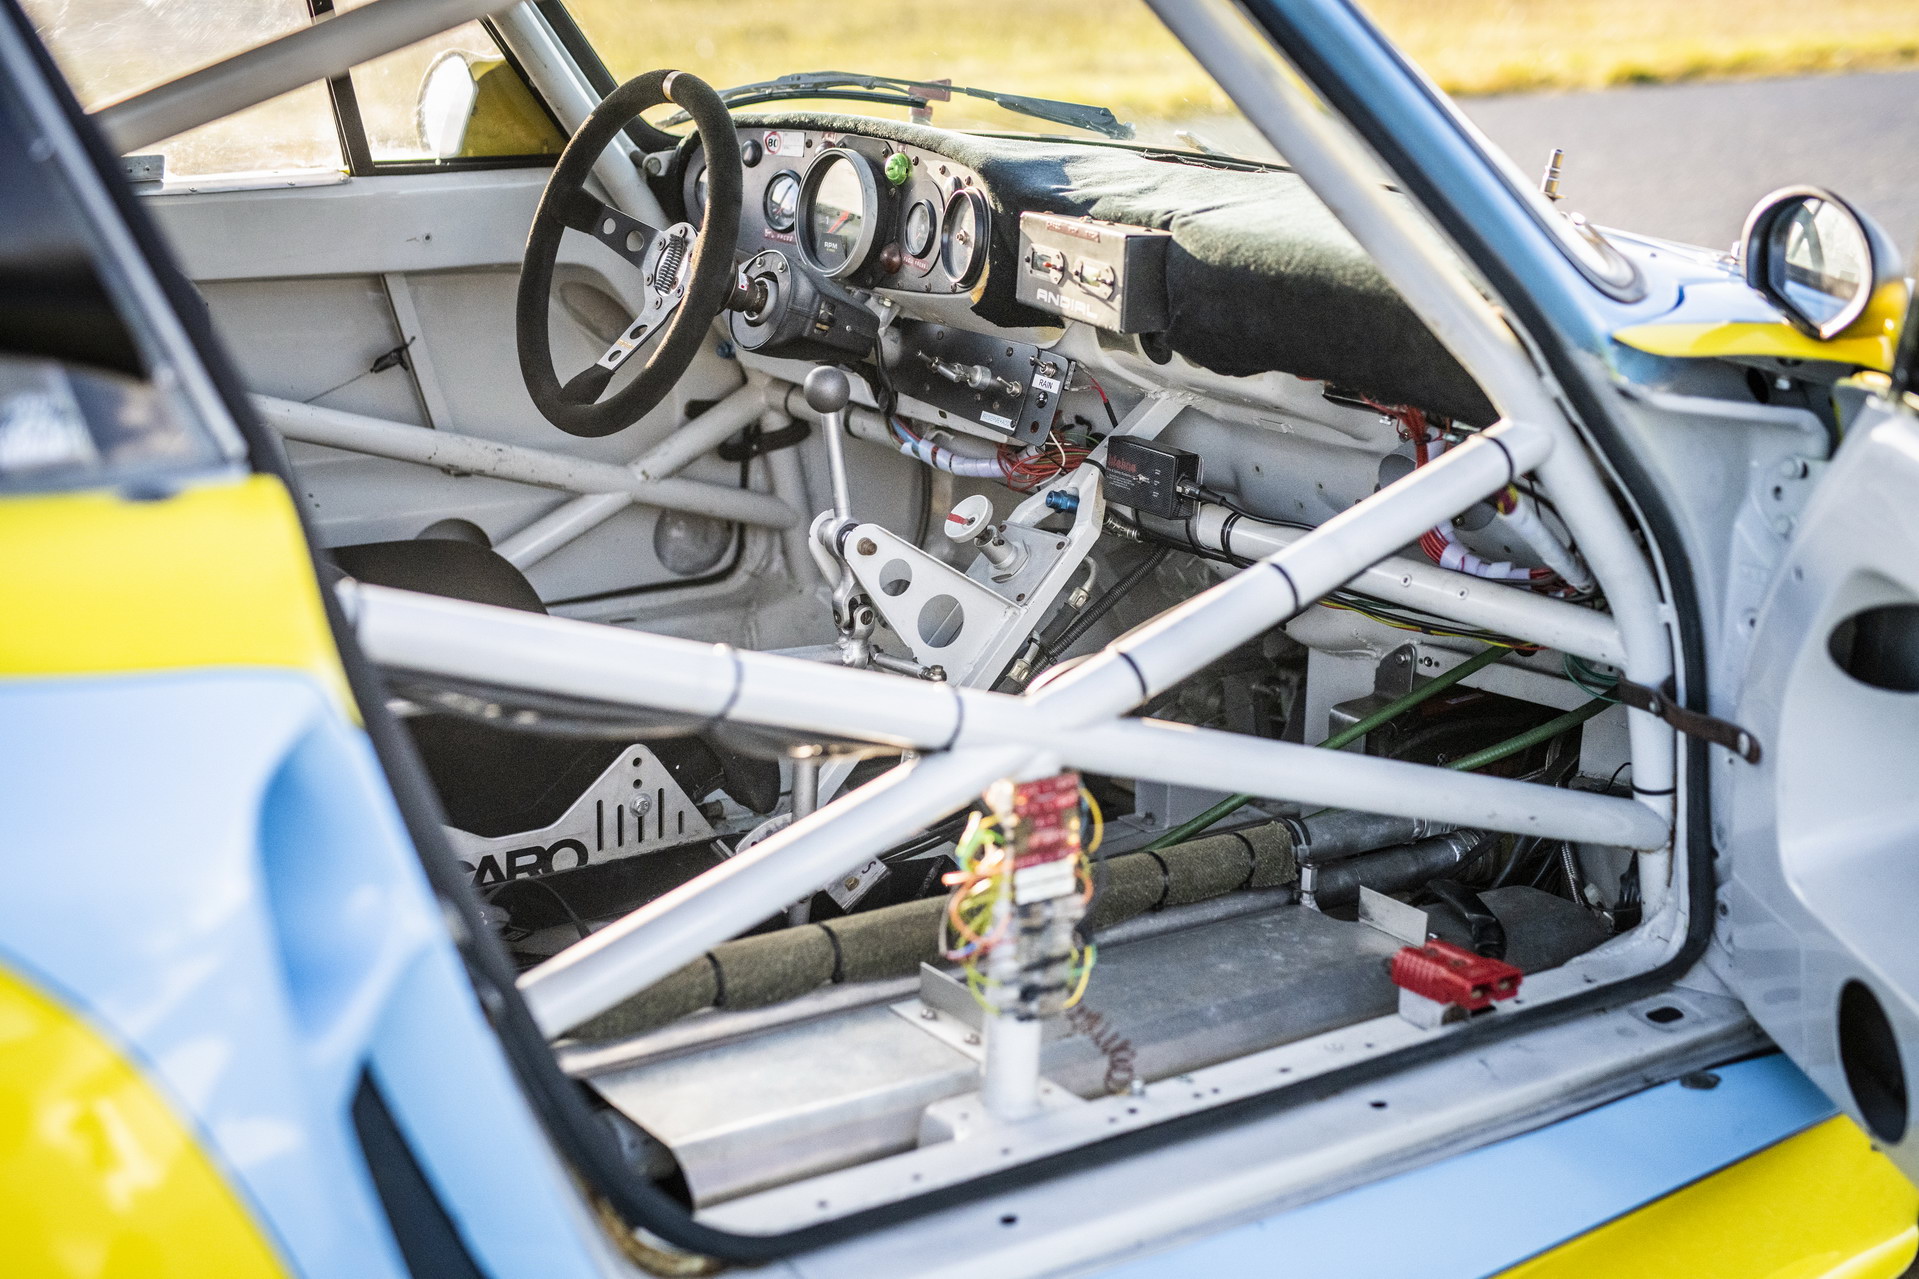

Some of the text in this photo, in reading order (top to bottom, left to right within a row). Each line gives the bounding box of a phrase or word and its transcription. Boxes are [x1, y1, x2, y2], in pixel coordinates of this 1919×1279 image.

[824, 241, 838, 250] RPM
[1036, 287, 1098, 319] ANDIAL
[1038, 378, 1054, 390] RAIN
[458, 838, 589, 888] ARO
